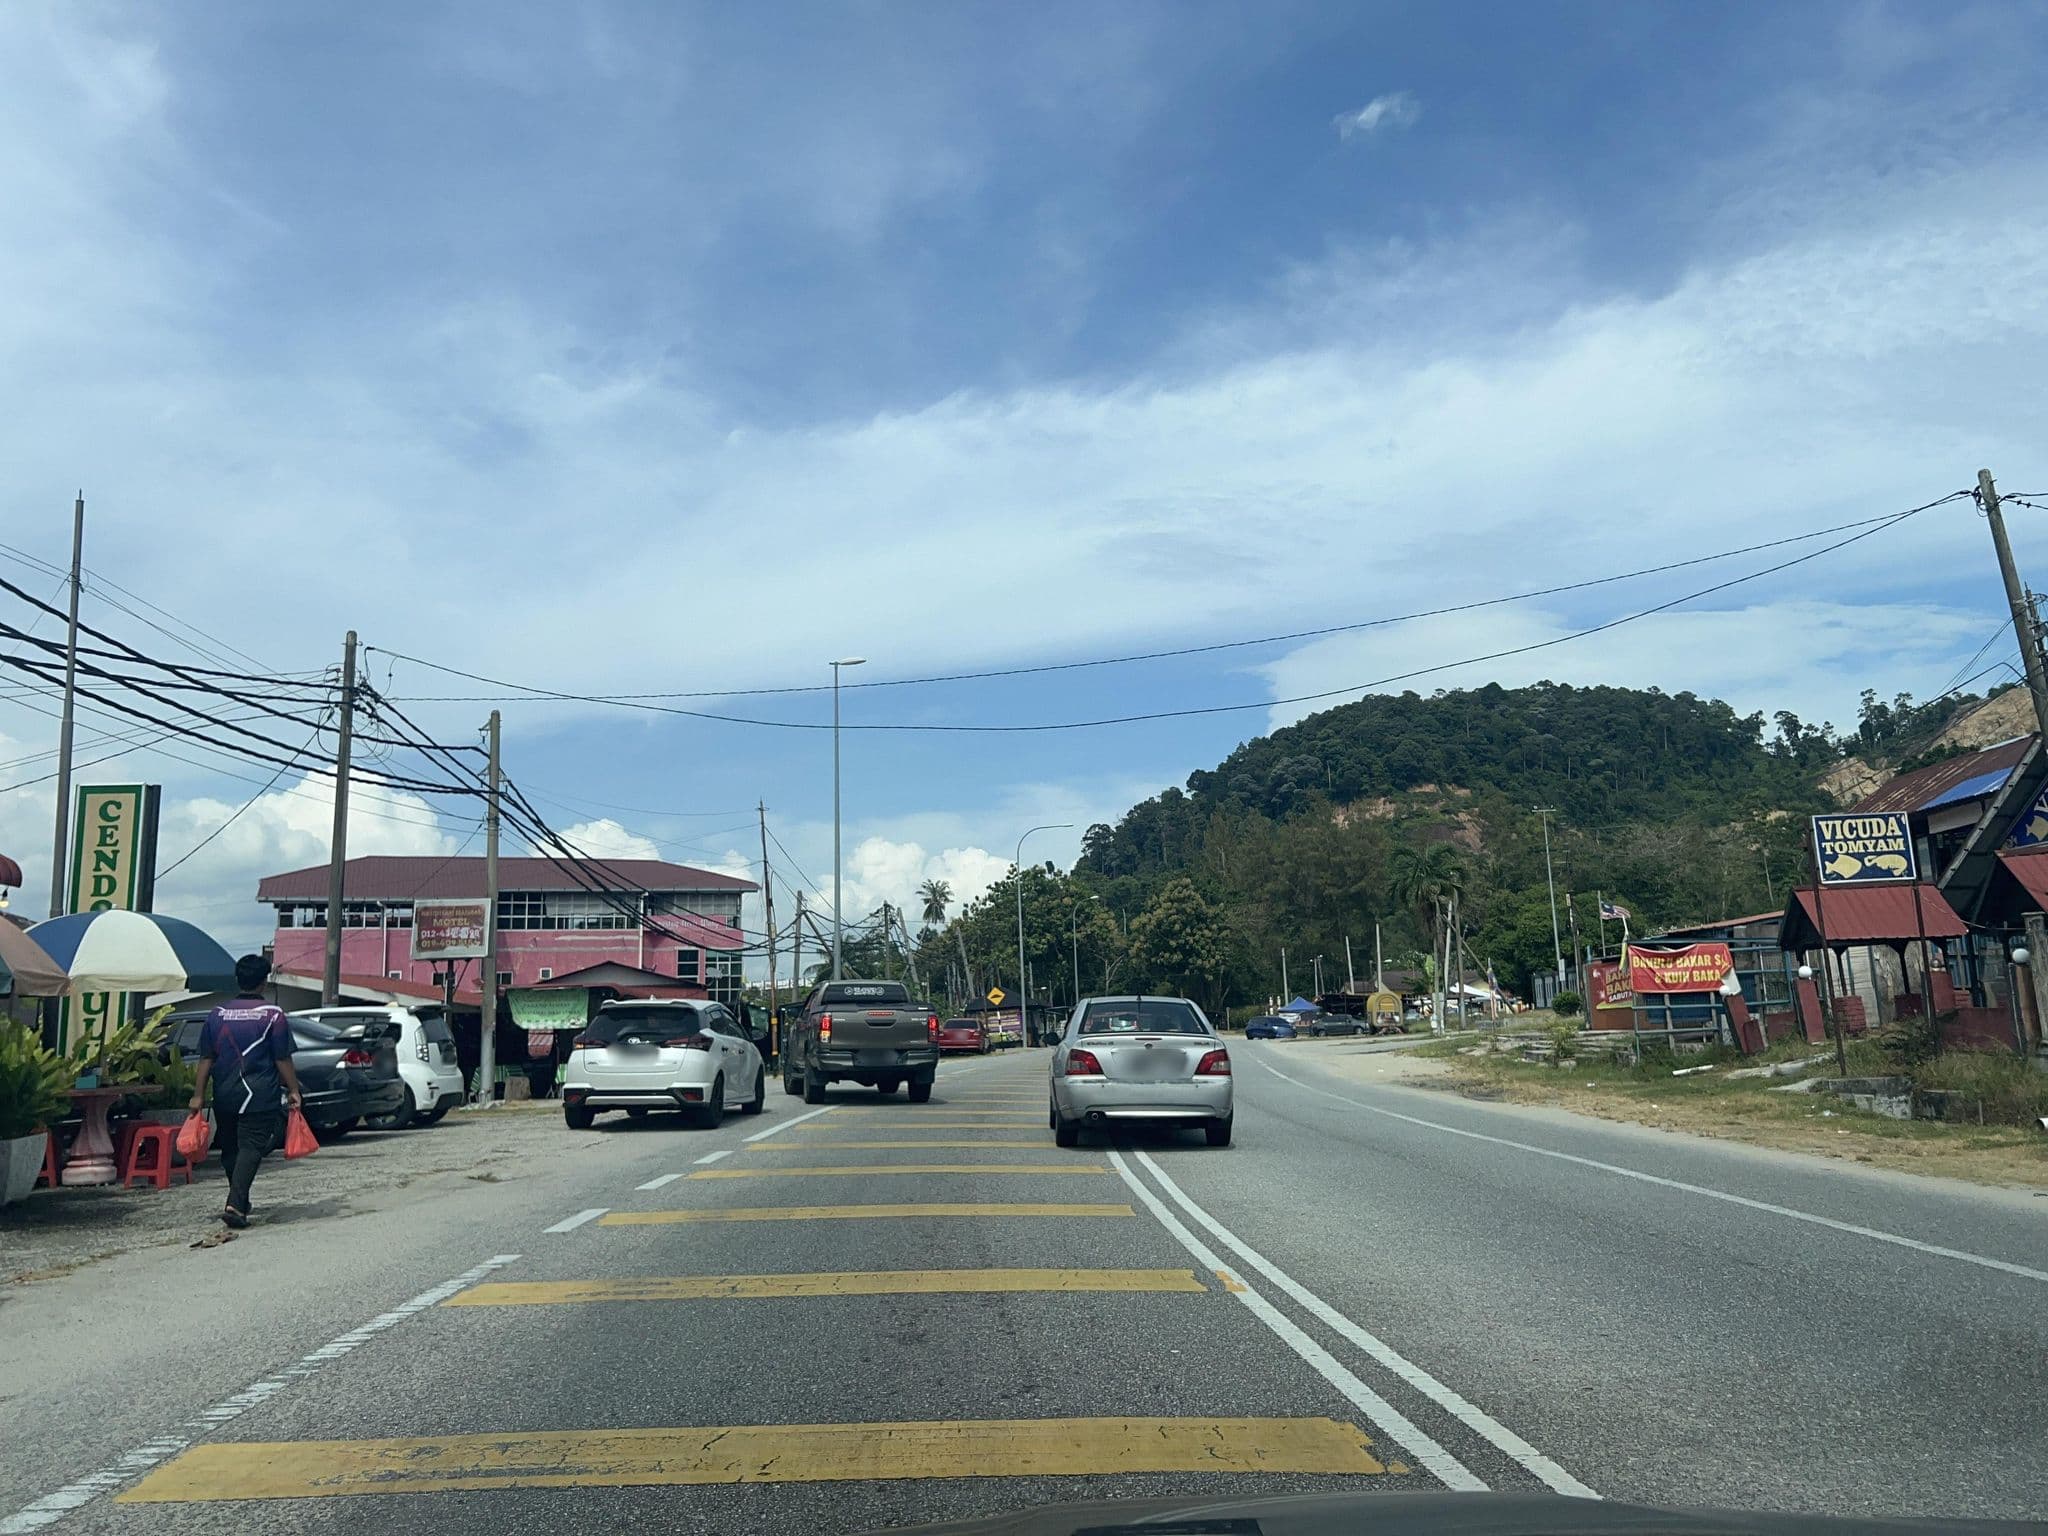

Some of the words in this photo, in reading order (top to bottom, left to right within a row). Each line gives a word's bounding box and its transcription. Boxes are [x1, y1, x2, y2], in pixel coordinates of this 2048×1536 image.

[1818, 816, 1903, 840] VICUDA
[1821, 838, 1906, 855] TOMYAM
[432, 917, 470, 927] MOTEL
[1676, 954, 1712, 969] BAKAR
[1665, 971, 1691, 984] KUIH
